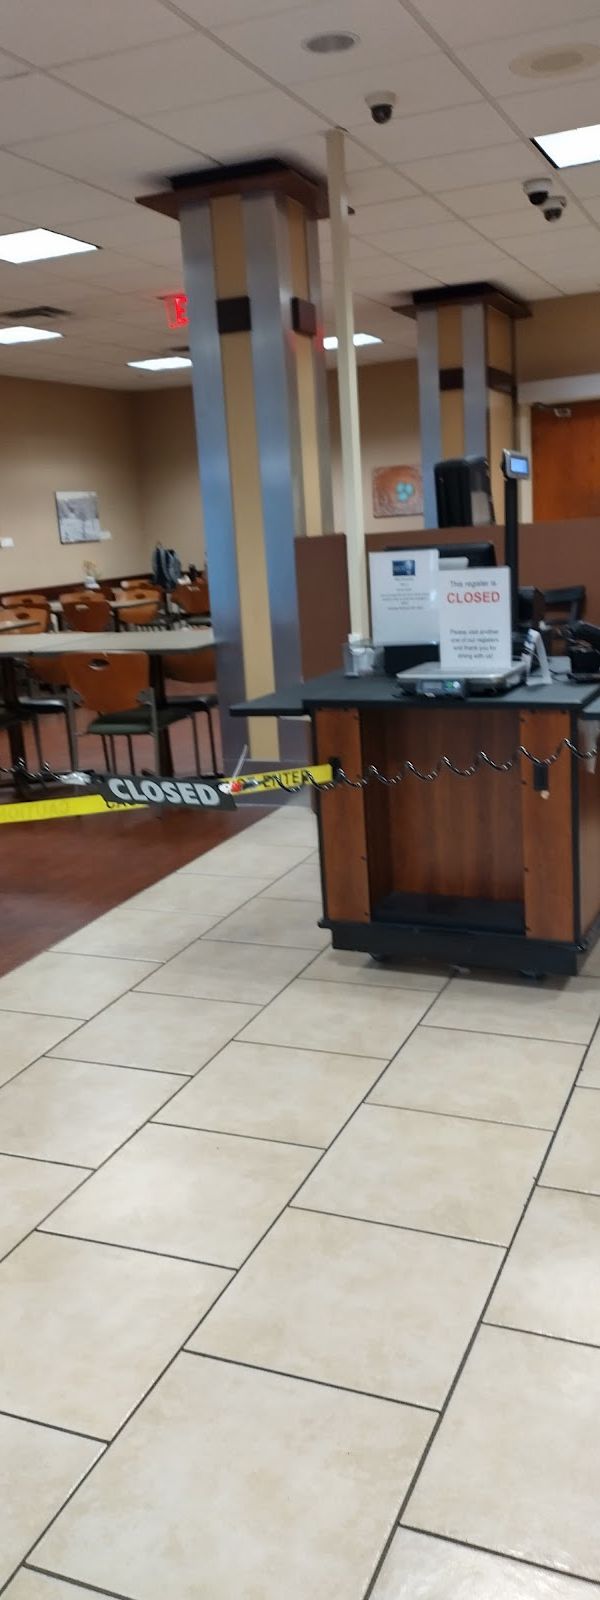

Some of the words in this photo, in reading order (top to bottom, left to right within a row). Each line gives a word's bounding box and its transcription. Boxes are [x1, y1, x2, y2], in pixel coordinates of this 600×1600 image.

[464, 580, 488, 588] register
[447, 591, 500, 603] CLOSED
[108, 777, 221, 807] CLOSED
